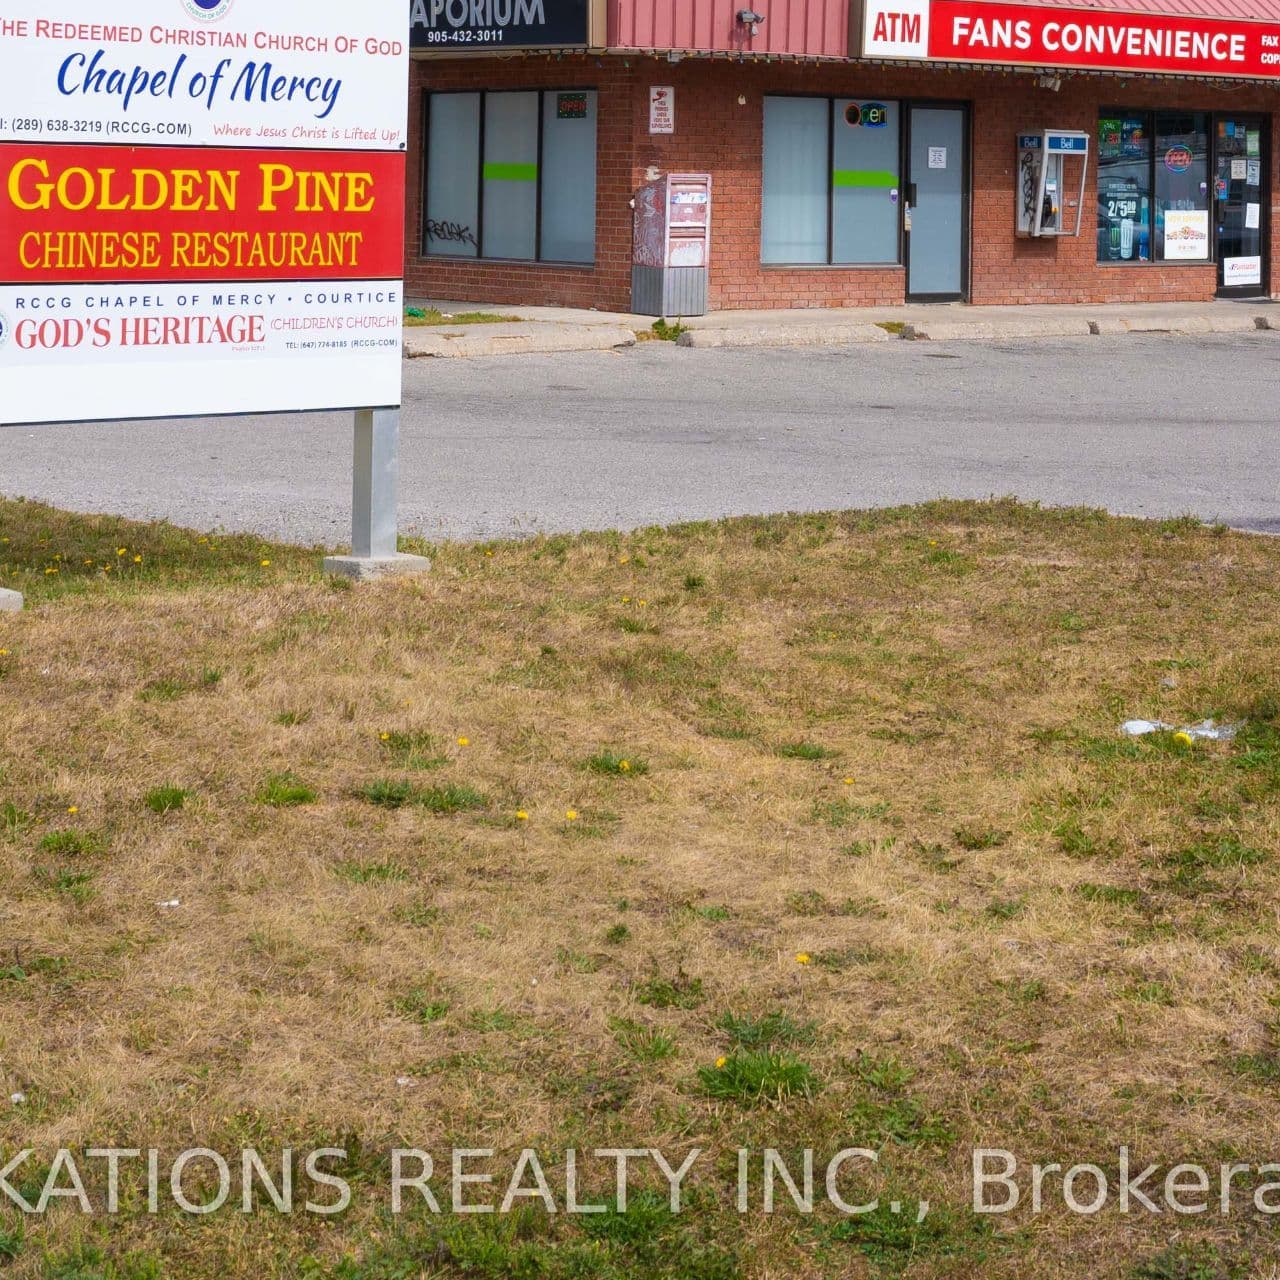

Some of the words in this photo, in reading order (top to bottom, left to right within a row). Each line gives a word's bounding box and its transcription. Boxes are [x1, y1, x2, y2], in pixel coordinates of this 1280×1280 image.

[35, 19, 142, 43] REDEEMED
[149, 25, 247, 49] CHRISTIAN
[254, 31, 328, 53] CHURCH
[334, 35, 358, 54] OF
[365, 38, 402, 56] GOD
[428, 30, 503, 42] 905-432-3011
[873, 11, 921, 44] ATM
[952, 16, 1032, 50] FANS
[1042, 22, 1246, 61] CONVENIENCE
[1261, 35, 1279, 47] FAX
[57, 49, 187, 111] Chapel
[188, 59, 231, 110] of
[230, 61, 342, 119] Mercy
[844, 102, 887, 127] Open
[11, 119, 43, 133] (289)
[46, 119, 102, 133] 638-3219
[106, 120, 192, 137] (RCCG-COM)
[213, 124, 254, 137] Where
[256, 125, 288, 138] Jesus
[291, 125, 327, 139] Christ
[331, 127, 340, 139] is
[344, 127, 378, 140] Lifted
[381, 128, 400, 142] Up!
[1024, 137, 1038, 148] Bell
[1061, 138, 1074, 149] Bell
[7, 158, 241, 211] GOLDEN
[258, 163, 376, 213] PINE
[19, 231, 161, 269] CHINESE
[170, 231, 363, 268] RESTAURANT
[15, 297, 72, 309] RCCG
[85, 294, 164, 308] CHAPEL
[177, 294, 200, 306] OF
[212, 293, 276, 306] MERCY
[304, 292, 397, 305] COURTICE
[14, 317, 111, 349] GOD'S
[120, 314, 266, 347] HERITAGE
